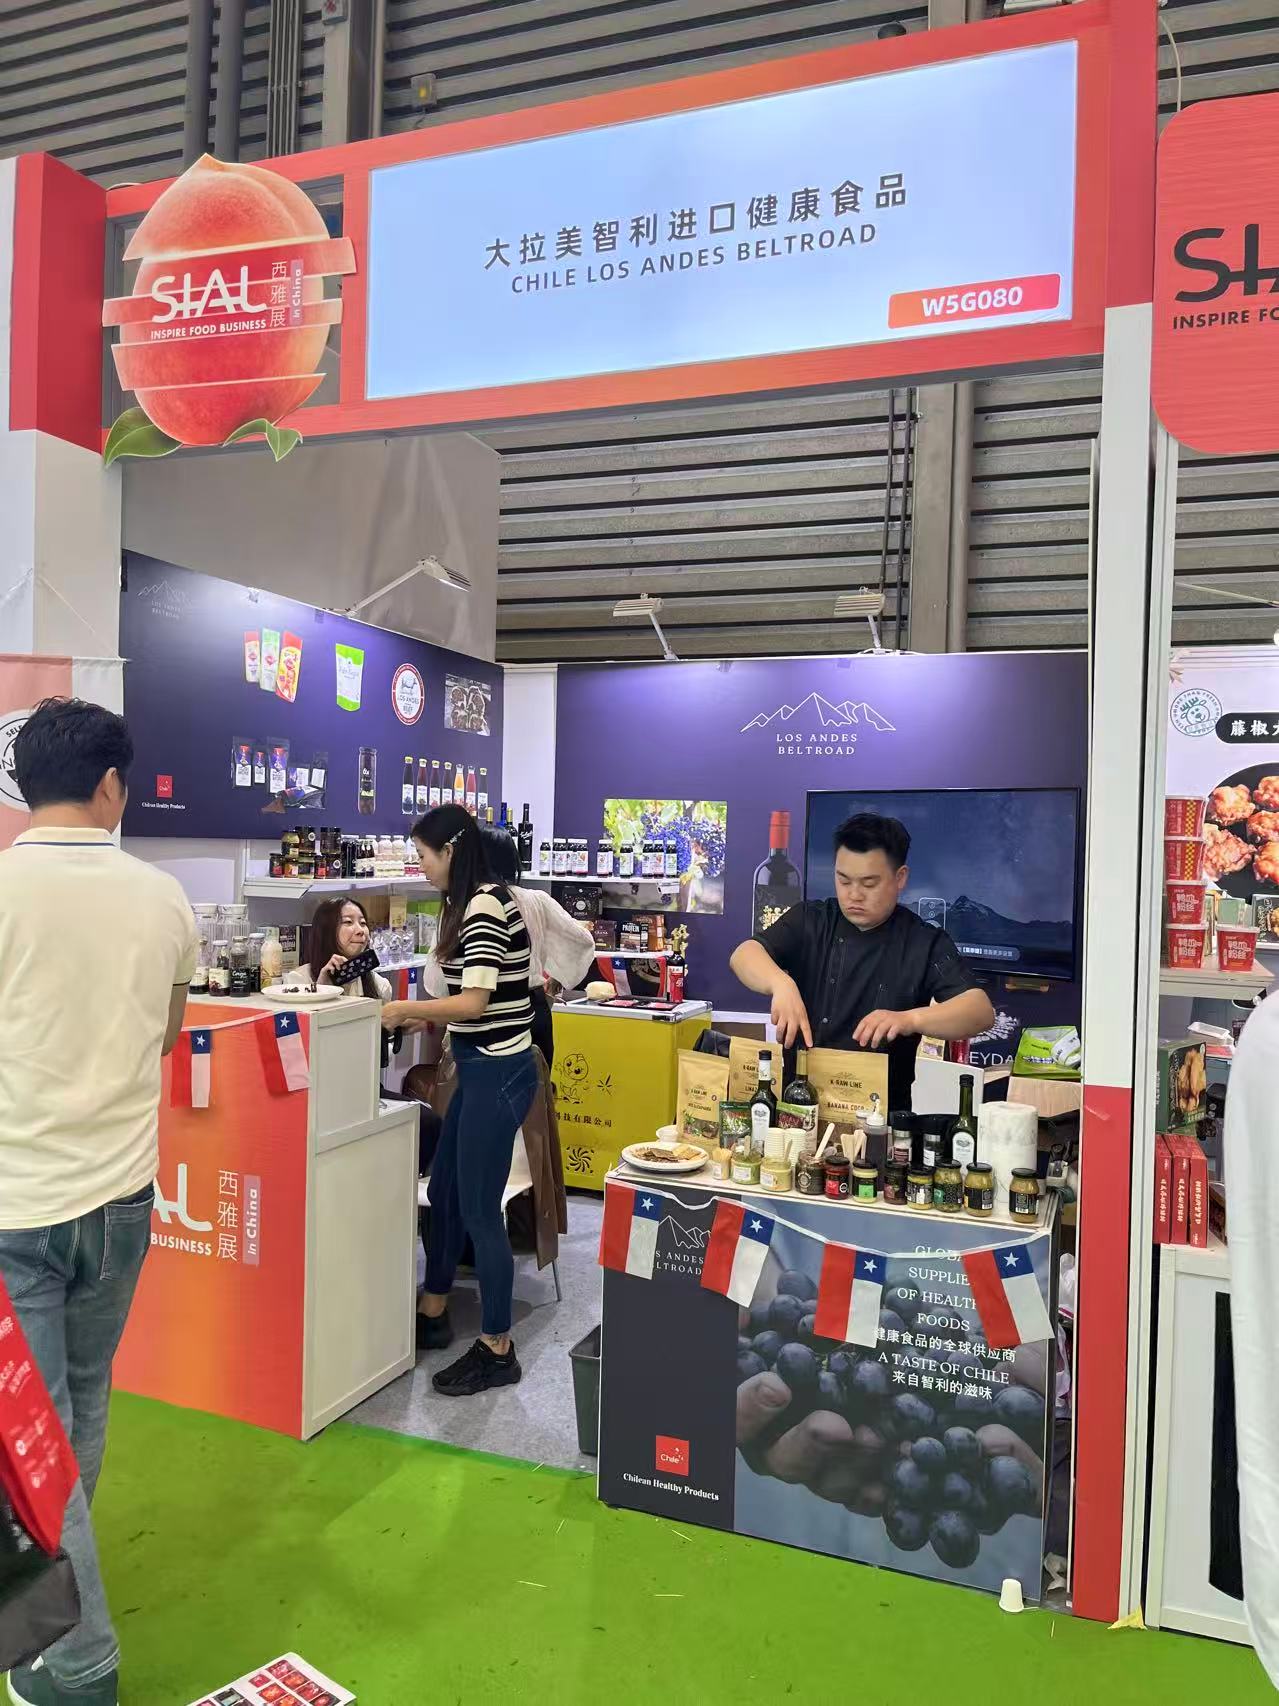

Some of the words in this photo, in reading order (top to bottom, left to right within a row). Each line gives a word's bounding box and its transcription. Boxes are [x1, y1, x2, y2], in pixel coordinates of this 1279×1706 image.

[484, 173, 906, 270] 大拉美智利进口健康食品
[511, 268, 576, 293] CHILE
[587, 260, 630, 283] LOS
[640, 245, 725, 276] ANDES
[737, 223, 877, 262] BELTROAD
[1174, 223, 1279, 303] SI
[151, 265, 267, 323] SIAL
[270, 261, 288, 328] 西雅展
[292, 269, 302, 306] China
[921, 286, 1023, 317] W5G080
[151, 327, 186, 340] INSPIRE
[189, 324, 217, 336] FOOD
[220, 319, 267, 333] BUSINESS
[1173, 310, 1250, 330] INSPIRE
[776, 733, 802, 742] LOS
[809, 733, 858, 742] ANDES
[778, 746, 855, 755] BELTROAD
[217, 1169, 239, 1262] 西雅展
[246, 1188, 257, 1239] China
[150, 1232, 212, 1256] BUSINESS
[666, 1251, 704, 1265] ANDES
[656, 1261, 702, 1275] LTROAD
[908, 1266, 970, 1286] SUPPLIE
[897, 1287, 918, 1300] OF
[916, 1312, 970, 1332] FOODS
[874, 1327, 1016, 1363] 健康食品的全球供应商
[877, 1352, 889, 1364] A
[892, 1353, 937, 1372] TASTE
[939, 1361, 960, 1376] OF
[963, 1366, 1010, 1385] CHILE
[892, 1370, 993, 1400] 来自智利的滋味
[623, 1472, 652, 1486] Chilean
[653, 1479, 682, 1494] Healthy
[684, 1485, 719, 1501] Products
